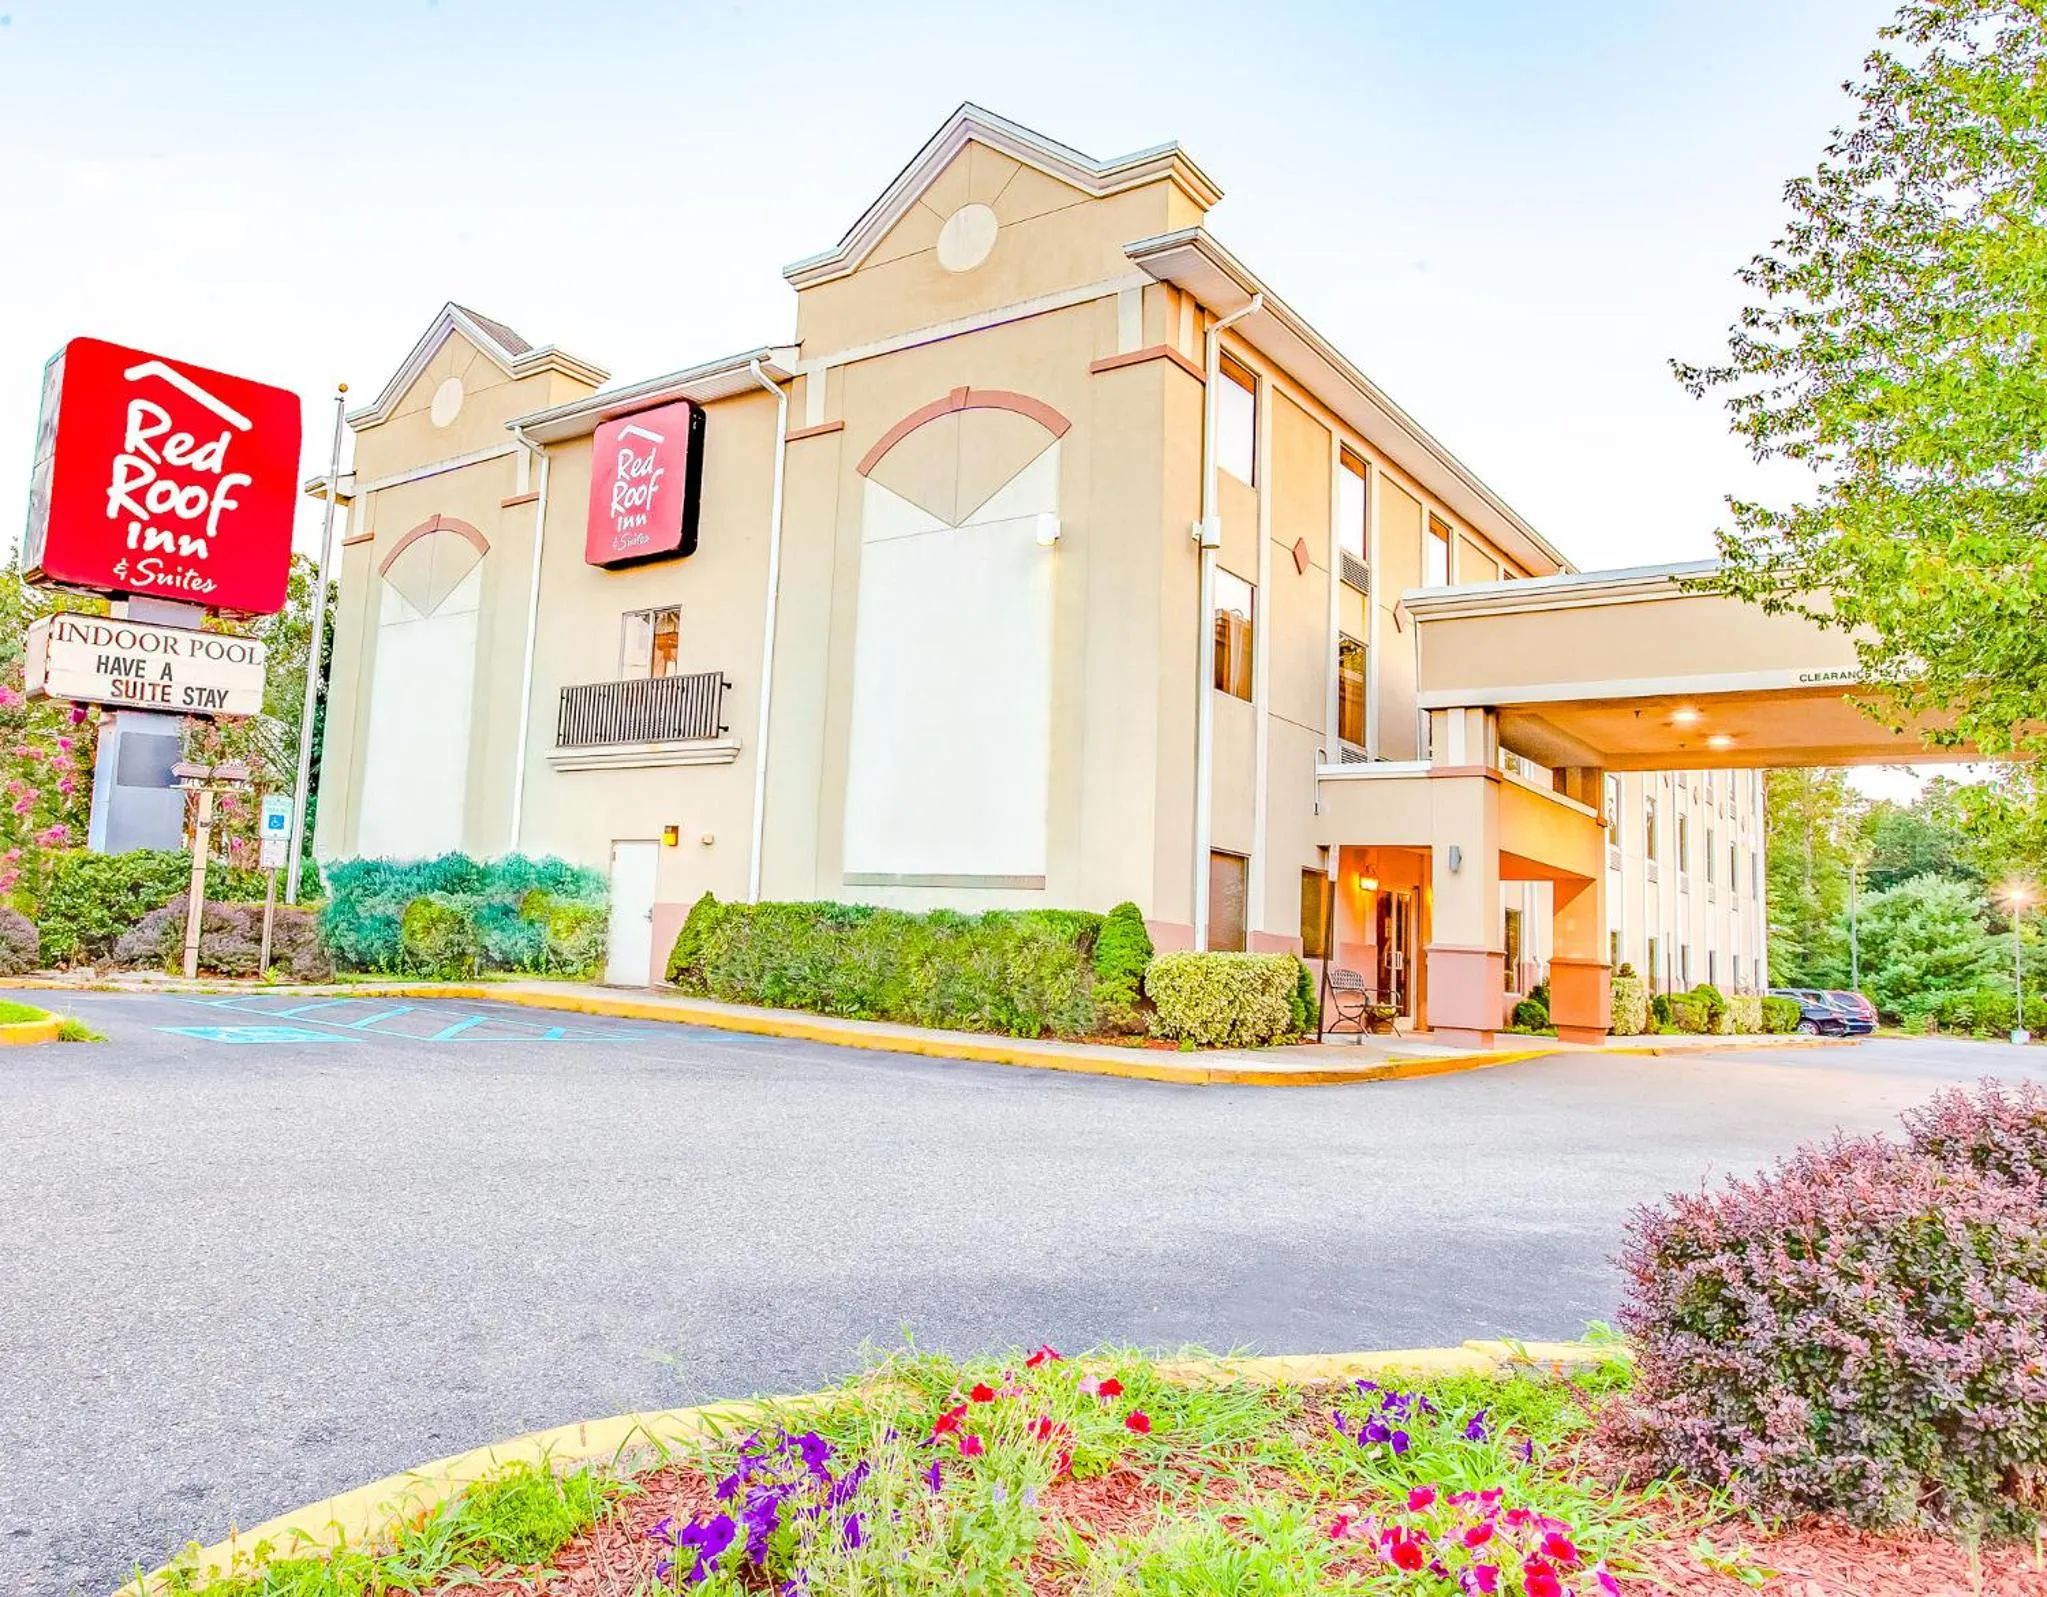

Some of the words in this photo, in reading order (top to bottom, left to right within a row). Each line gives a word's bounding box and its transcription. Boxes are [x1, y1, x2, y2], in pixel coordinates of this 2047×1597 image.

[125, 398, 232, 474] Red
[618, 447, 657, 481] Red
[106, 454, 253, 538] Roof
[610, 467, 665, 519] Roof
[618, 532, 650, 552] Suites
[112, 557, 128, 580] &
[130, 557, 218, 594] Suites
[55, 621, 180, 656] INDOOR
[188, 638, 262, 666] POOL
[96, 654, 146, 679] HAVE
[160, 662, 173, 682] A
[111, 679, 173, 703] SUITE
[182, 686, 229, 709] STAY
